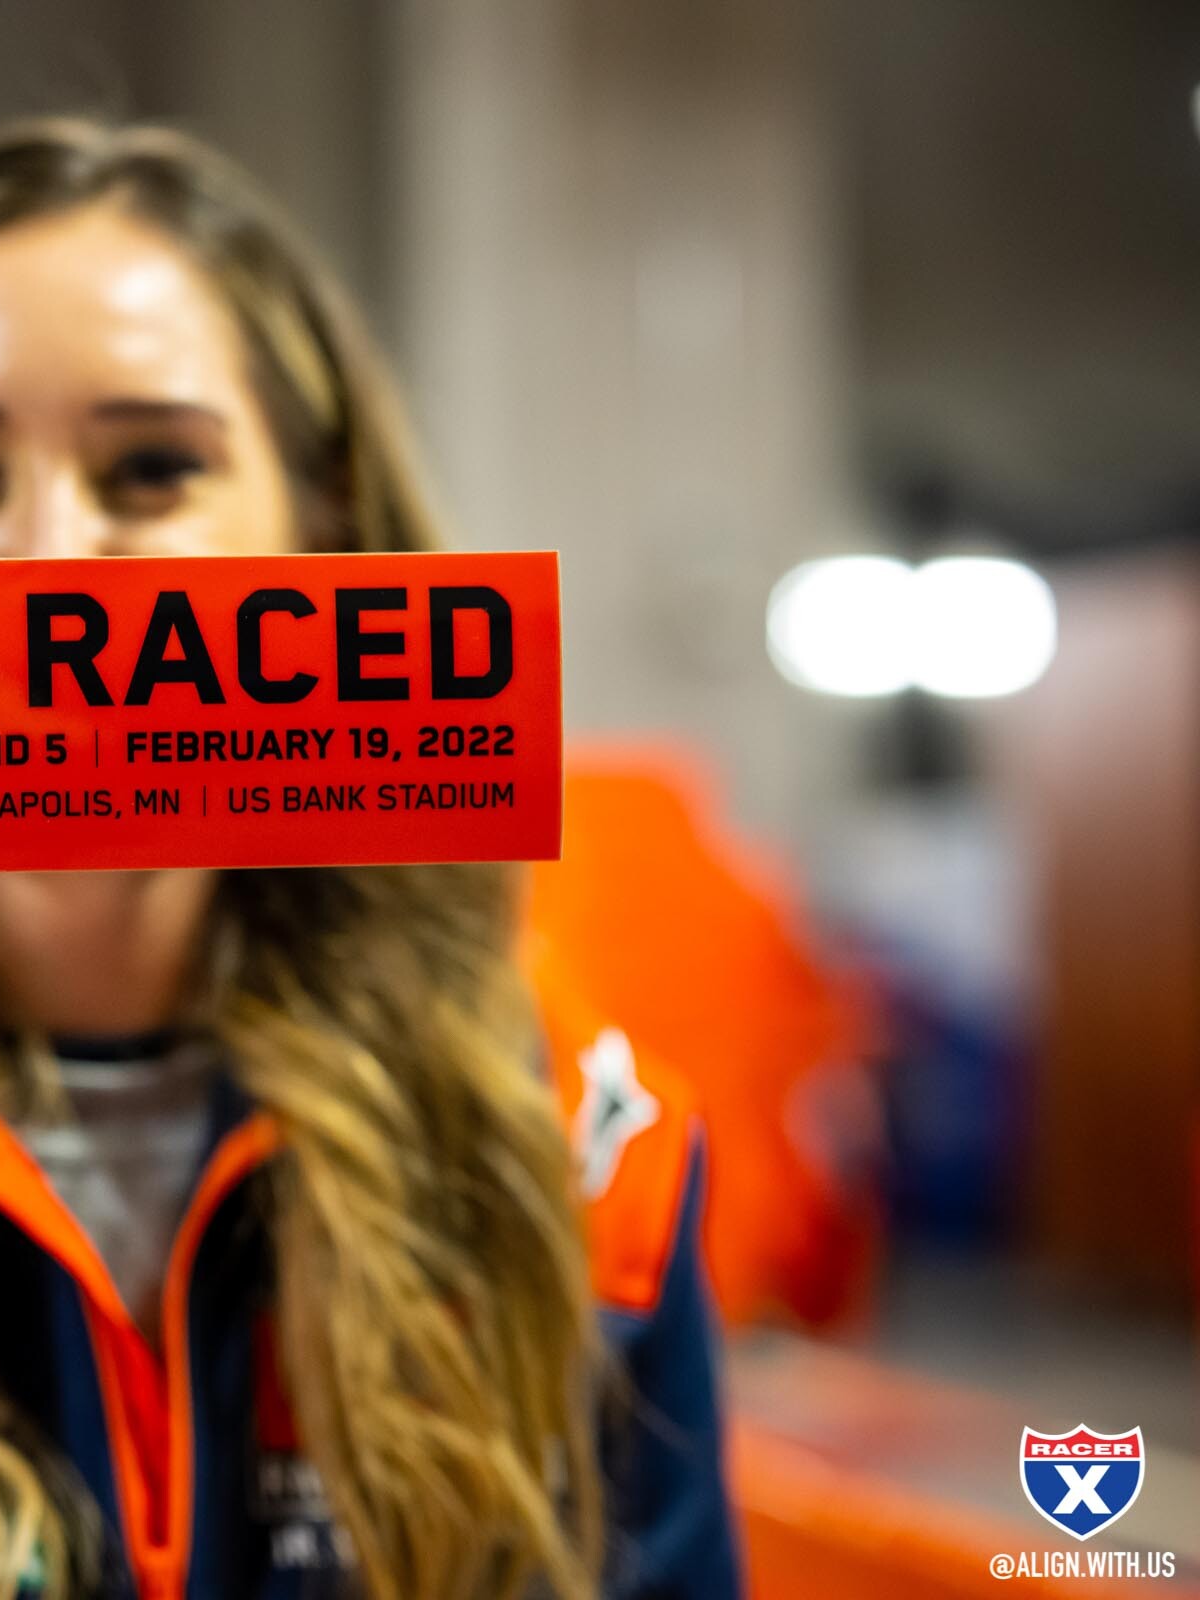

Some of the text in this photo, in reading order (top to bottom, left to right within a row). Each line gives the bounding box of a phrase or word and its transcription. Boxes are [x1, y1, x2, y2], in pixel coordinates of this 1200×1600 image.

[26, 585, 514, 708] RACED
[45, 733, 68, 765] 5
[126, 728, 336, 763] FEBRUARY
[349, 727, 402, 762] 19,
[417, 725, 515, 758] 2022
[134, 789, 181, 816] MN
[228, 787, 271, 814] US
[283, 785, 367, 813] BANK
[377, 783, 515, 811] STADIUM
